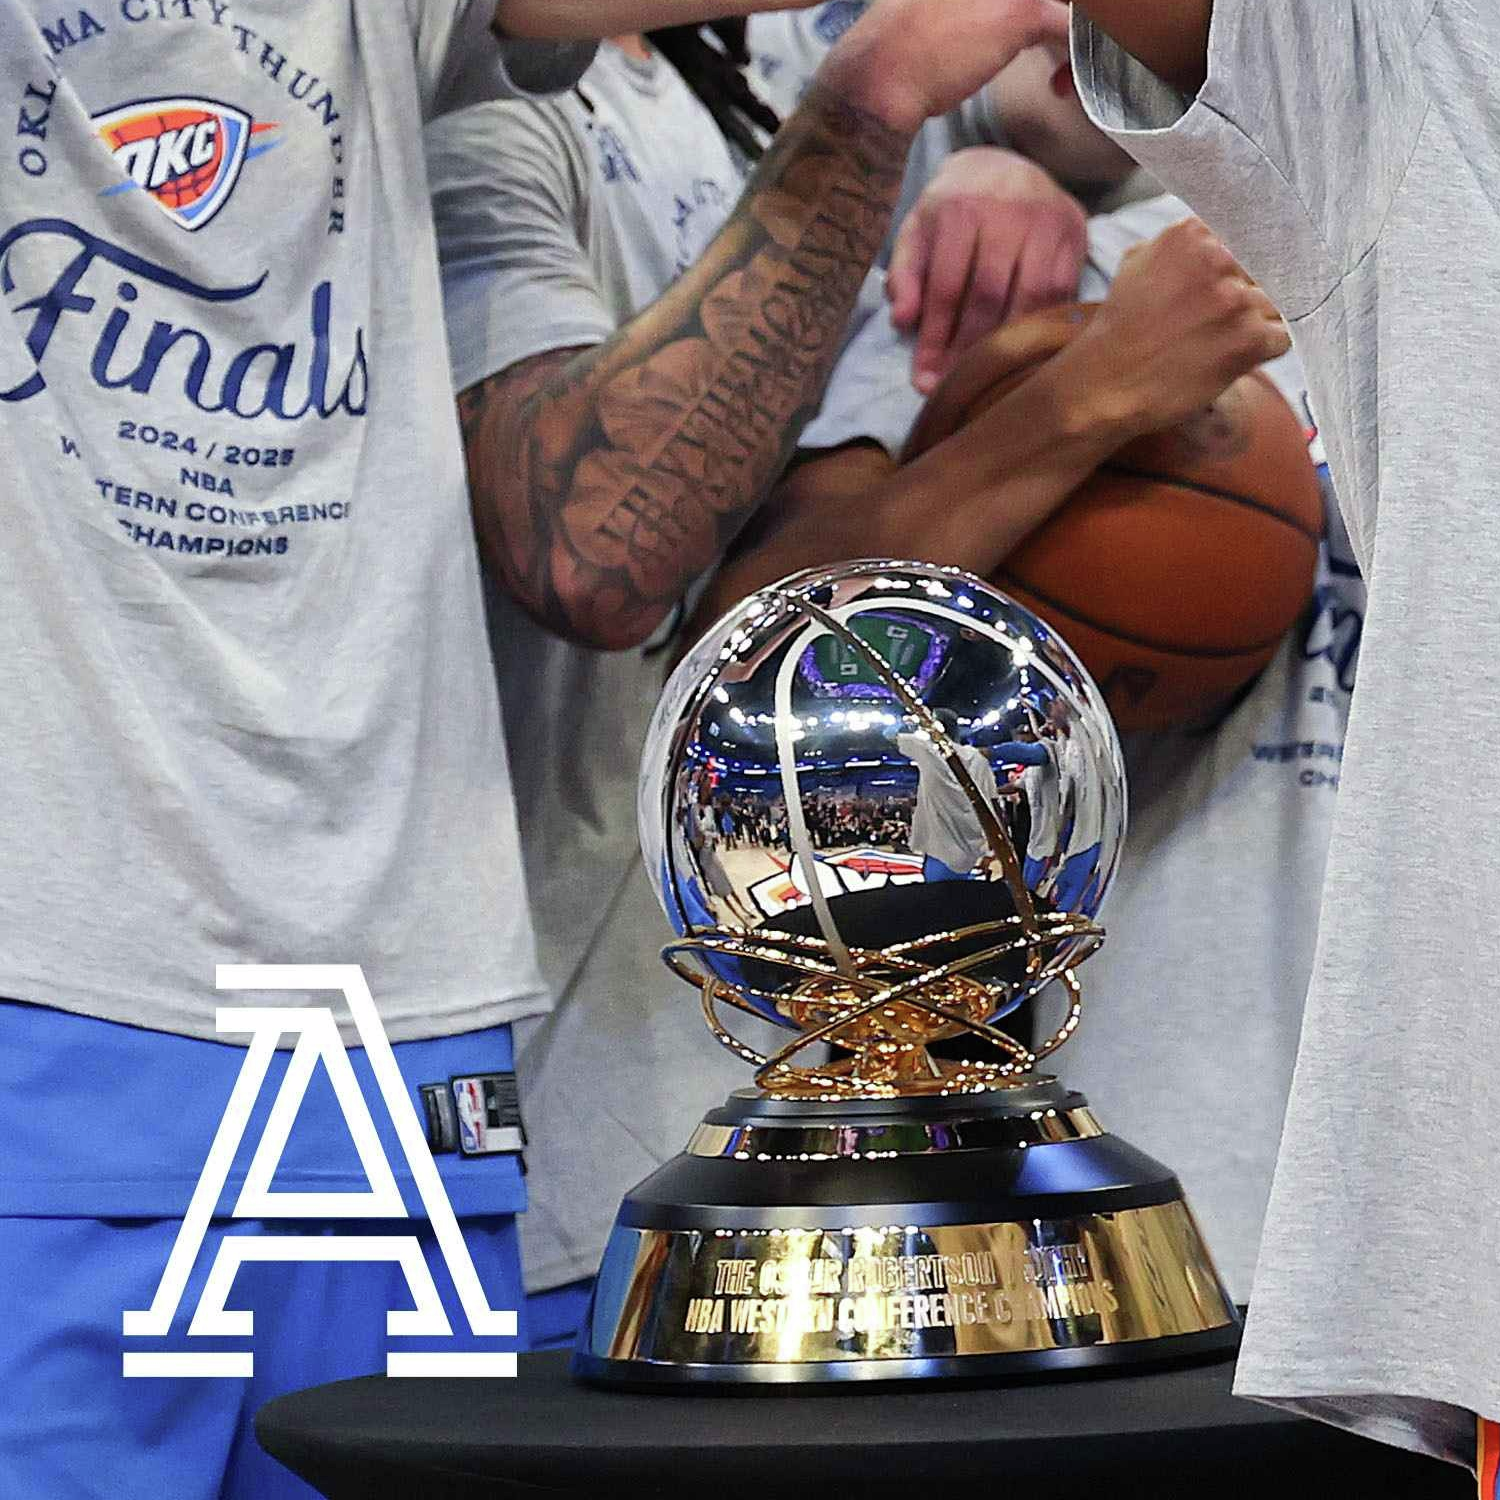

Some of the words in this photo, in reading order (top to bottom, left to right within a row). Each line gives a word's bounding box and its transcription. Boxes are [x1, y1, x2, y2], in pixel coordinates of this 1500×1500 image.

[0, 218, 369, 420] Finals
[118, 420, 198, 455] 2024
[206, 442, 217, 460] /
[180, 467, 234, 498] NBA
[714, 1258, 756, 1296] THE
[685, 1297, 726, 1334] NBA
